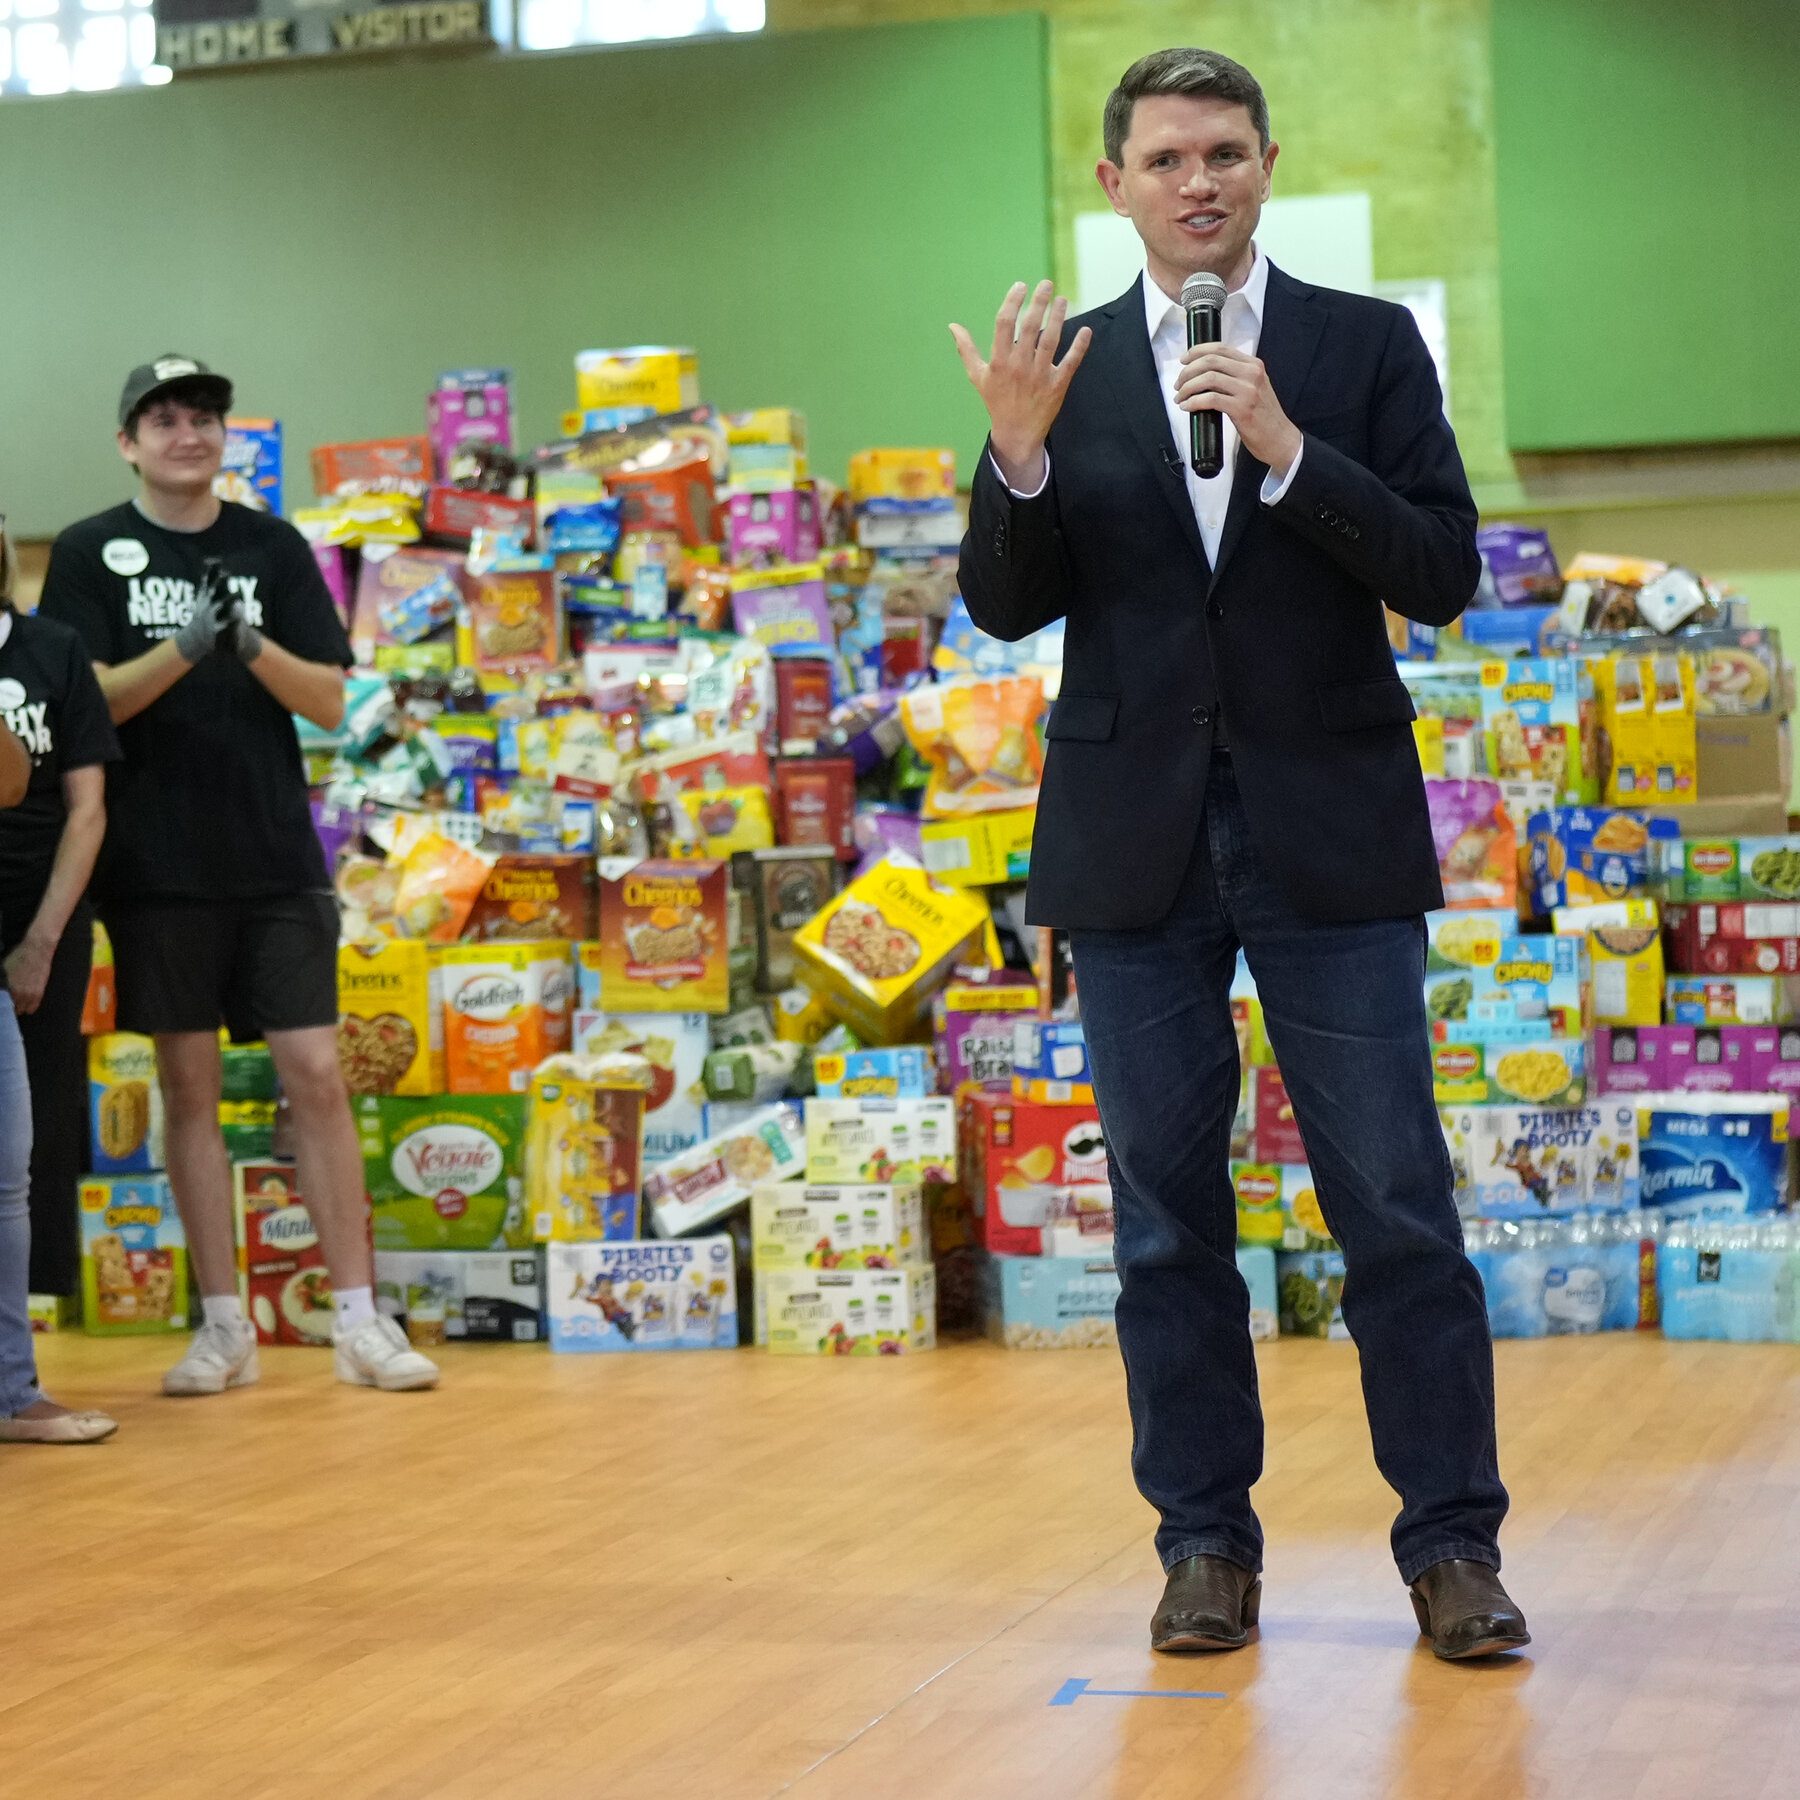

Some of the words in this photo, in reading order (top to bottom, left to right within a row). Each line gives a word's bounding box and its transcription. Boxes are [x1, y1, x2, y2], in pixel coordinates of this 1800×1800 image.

[157, 18, 290, 67] HOME
[331, 3, 481, 48] VISITOR
[1528, 1129, 1592, 1149] BOOTY
[1640, 1164, 1716, 1198] harmin
